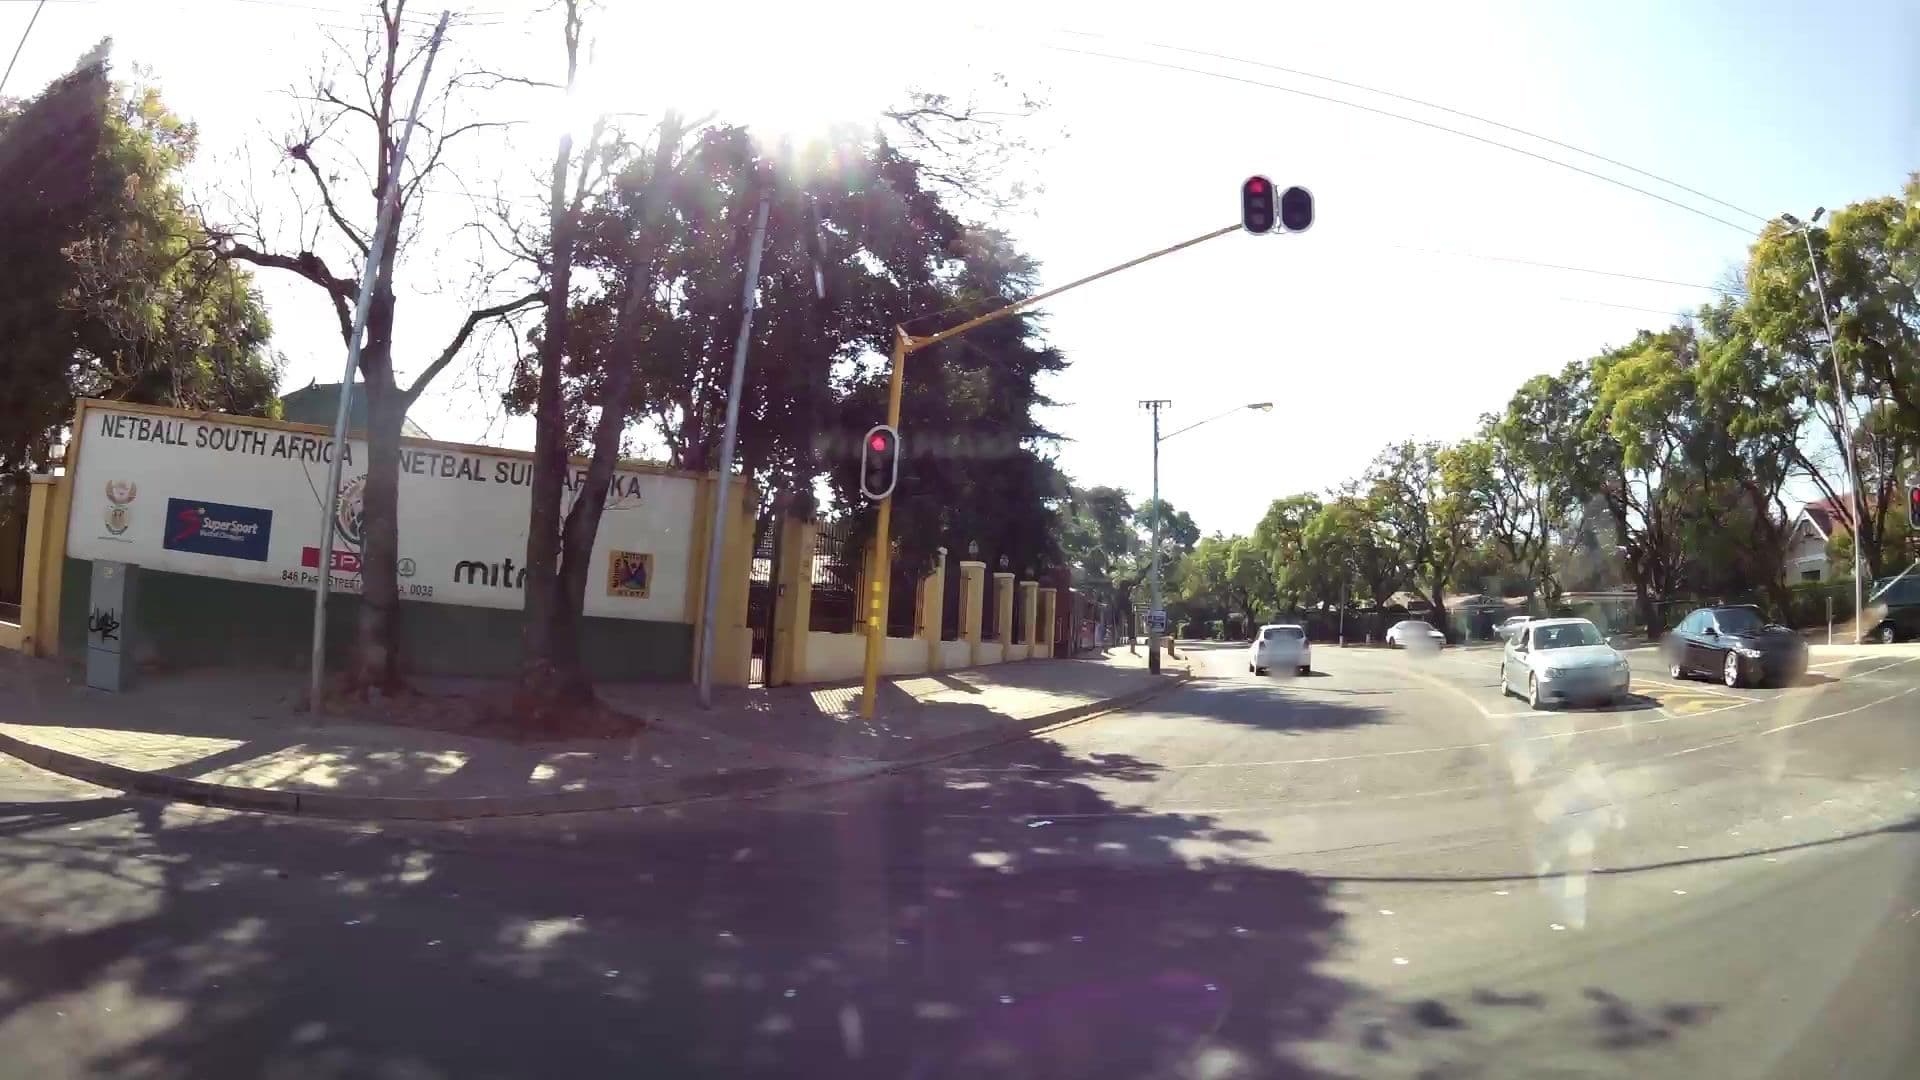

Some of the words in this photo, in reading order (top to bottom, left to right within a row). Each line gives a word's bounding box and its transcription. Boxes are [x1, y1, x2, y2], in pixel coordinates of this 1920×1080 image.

[101, 414, 188, 446] NETBALL
[196, 426, 267, 456] SOUTH
[399, 449, 487, 482] NETBAL
[494, 460, 533, 487] SUI
[202, 517, 258, 535] SuperSport
[454, 558, 527, 588] mitr
